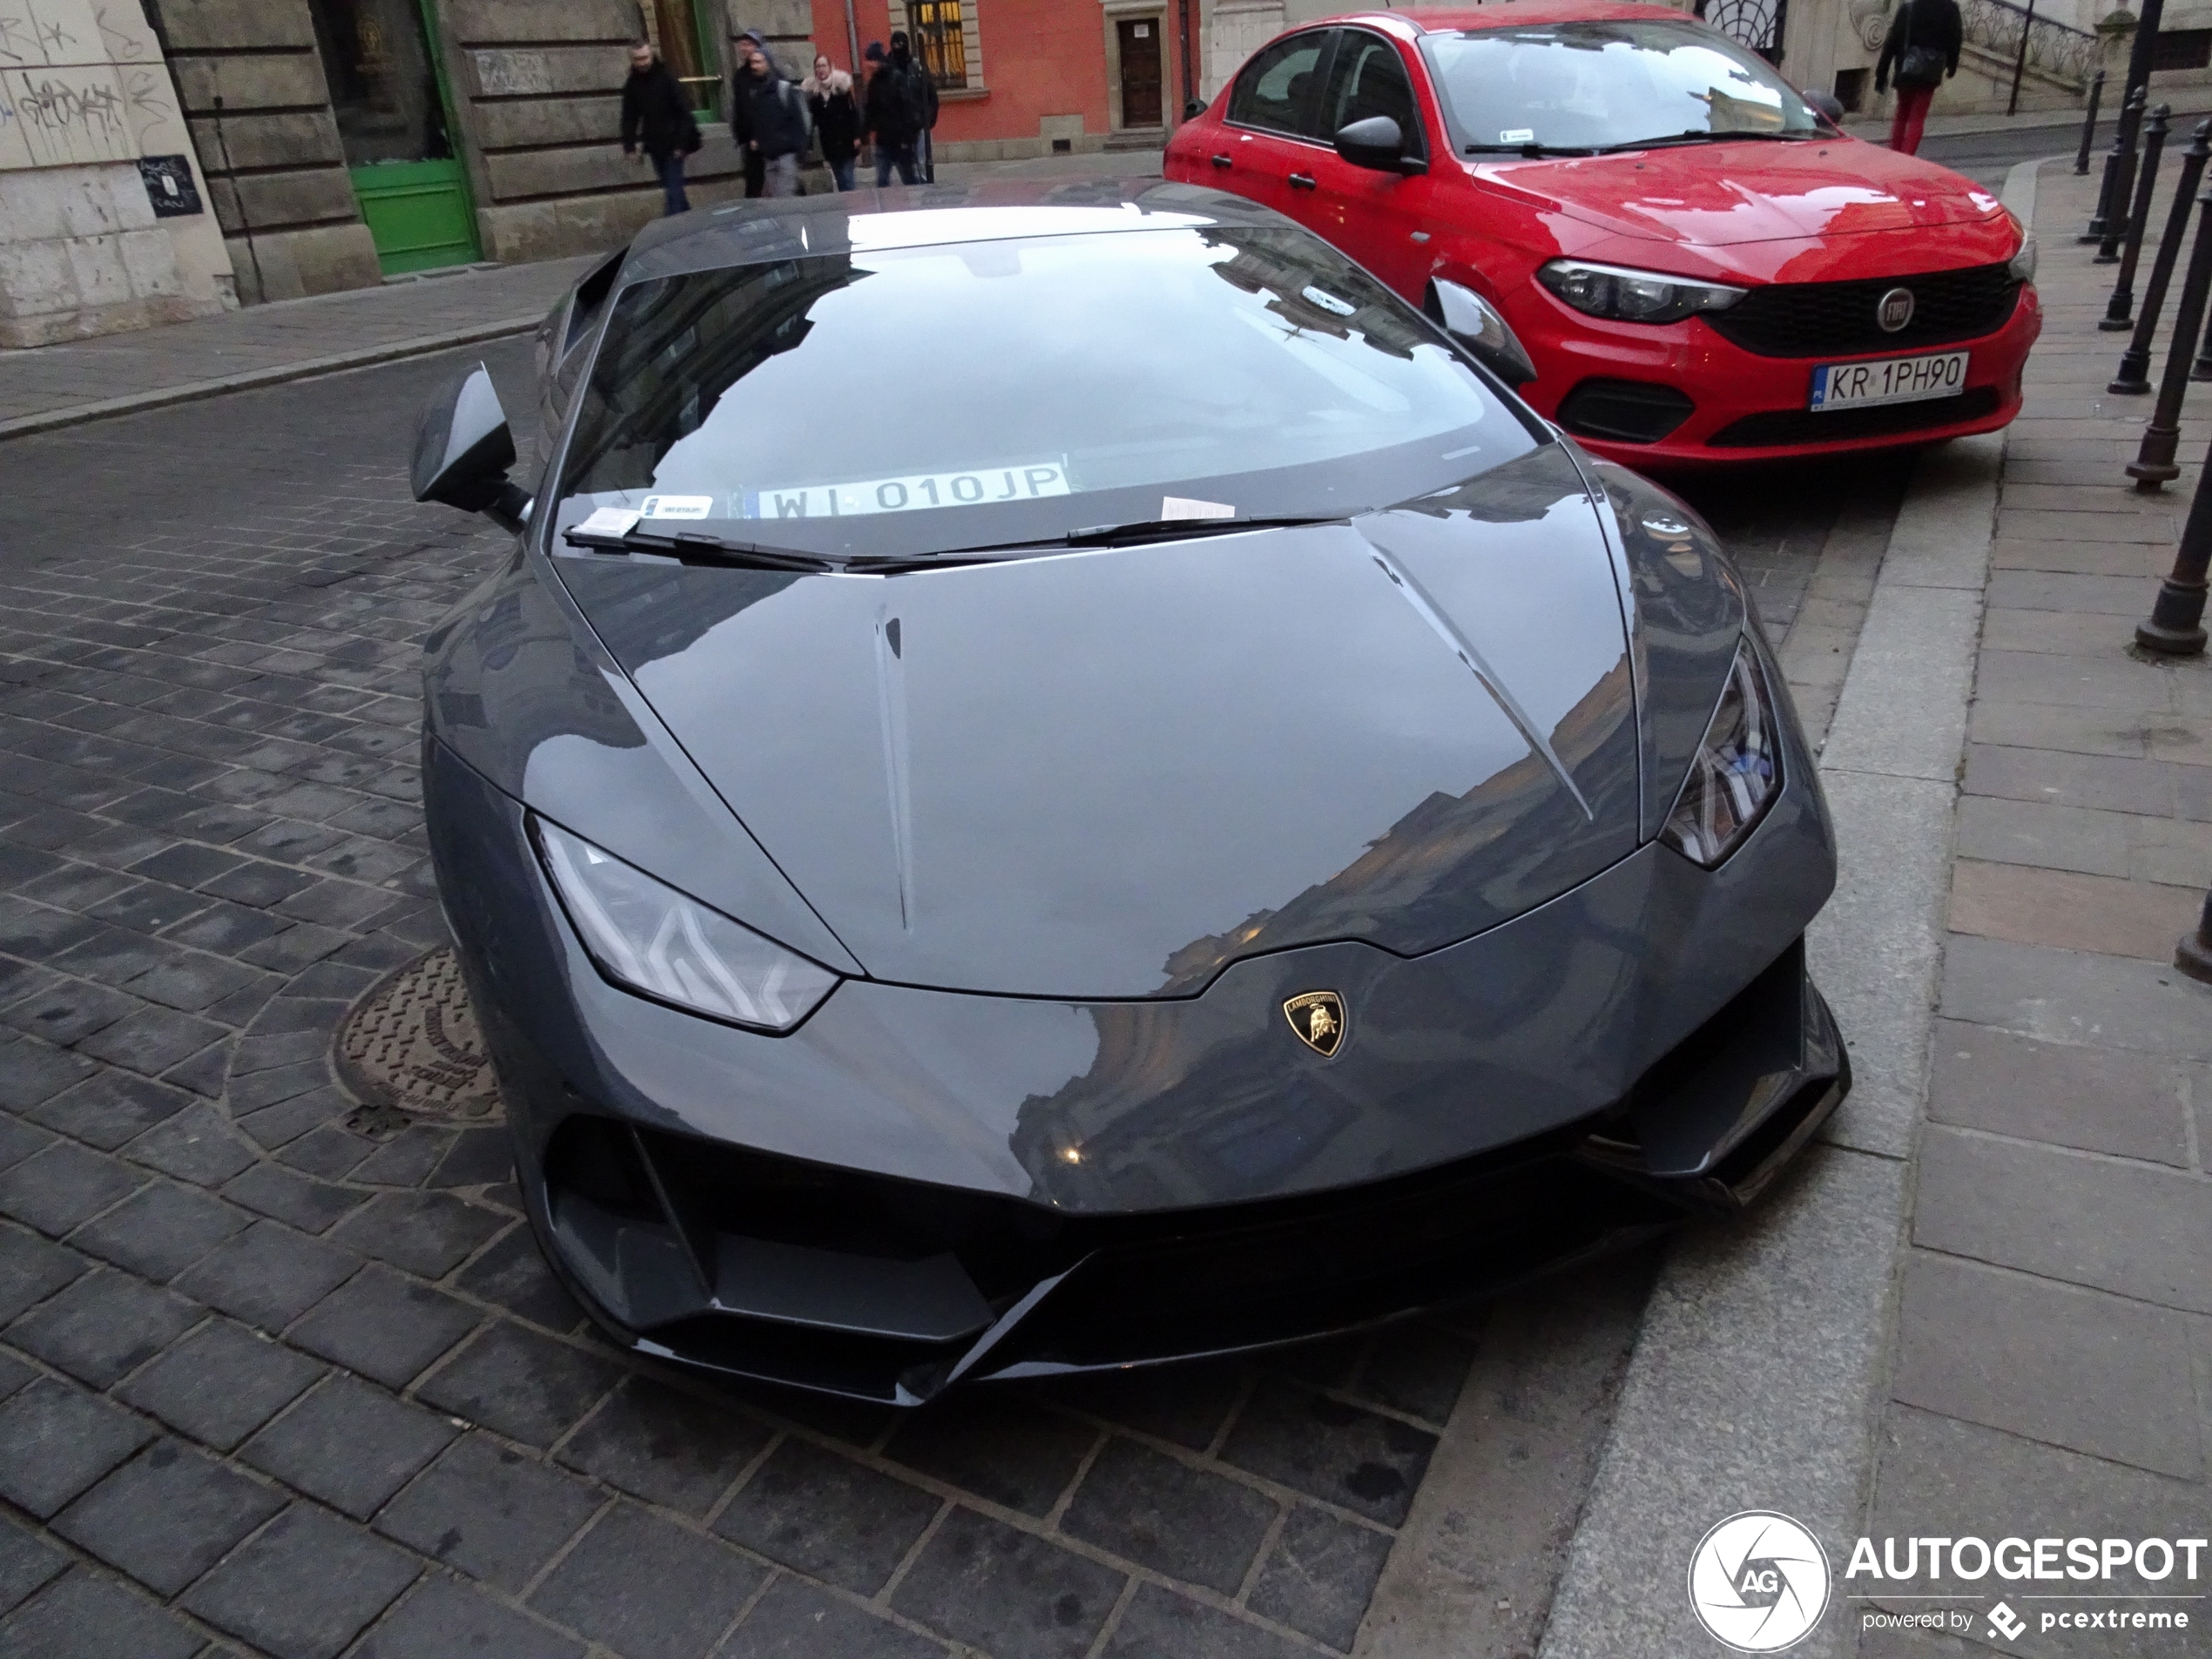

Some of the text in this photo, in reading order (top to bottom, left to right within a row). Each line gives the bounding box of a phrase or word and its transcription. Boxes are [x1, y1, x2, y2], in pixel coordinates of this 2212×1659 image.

[1886, 300, 1907, 320] FIAT
[1831, 356, 1961, 400] KR 1PH90
[774, 468, 1059, 518] WI 010JP
[1287, 995, 1337, 1012] LAMBORGHINI
